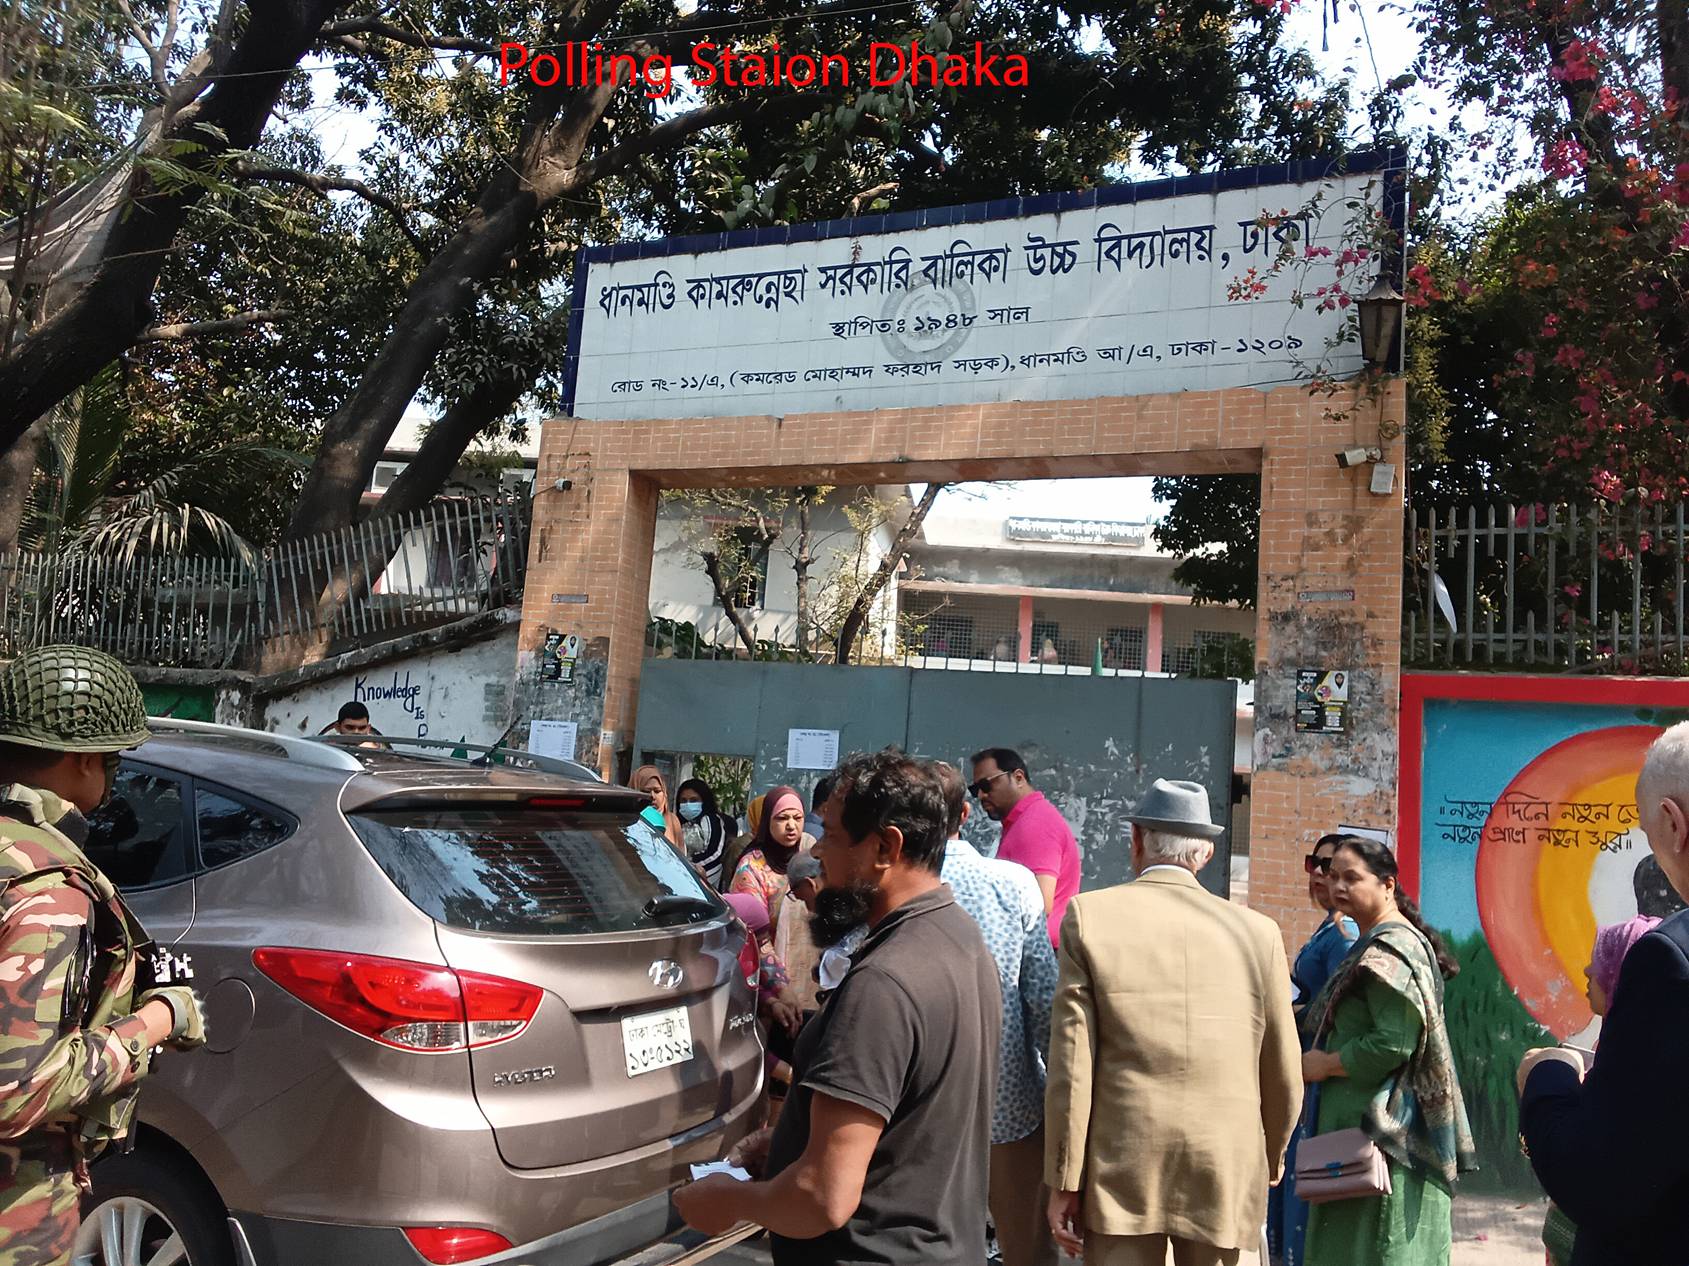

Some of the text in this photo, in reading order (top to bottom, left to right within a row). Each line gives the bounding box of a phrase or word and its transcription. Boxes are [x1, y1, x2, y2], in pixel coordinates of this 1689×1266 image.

[685, 263, 809, 313] কামরুন্নেছা
[817, 245, 914, 298] সরকারি
[919, 239, 1012, 291] বালিকা
[1022, 232, 1081, 276] উচ্চ
[1092, 222, 1230, 273] বিদ্যালয়,
[1237, 213, 1315, 258] ঢাকা
[913, 313, 978, 334] ১৯৪৮
[985, 305, 1032, 324] সাল
[611, 380, 644, 393] রোড
[729, 370, 798, 388] (কমরেড
[803, 365, 875, 383] মোহাম্মদ
[882, 360, 943, 377] ফরহাদ
[353, 670, 421, 713] Knowledge
[414, 705, 425, 720] Is
[1558, 802, 1614, 824] নতুন
[1435, 822, 1486, 845] নতুন
[1534, 827, 1580, 848] নতুন
